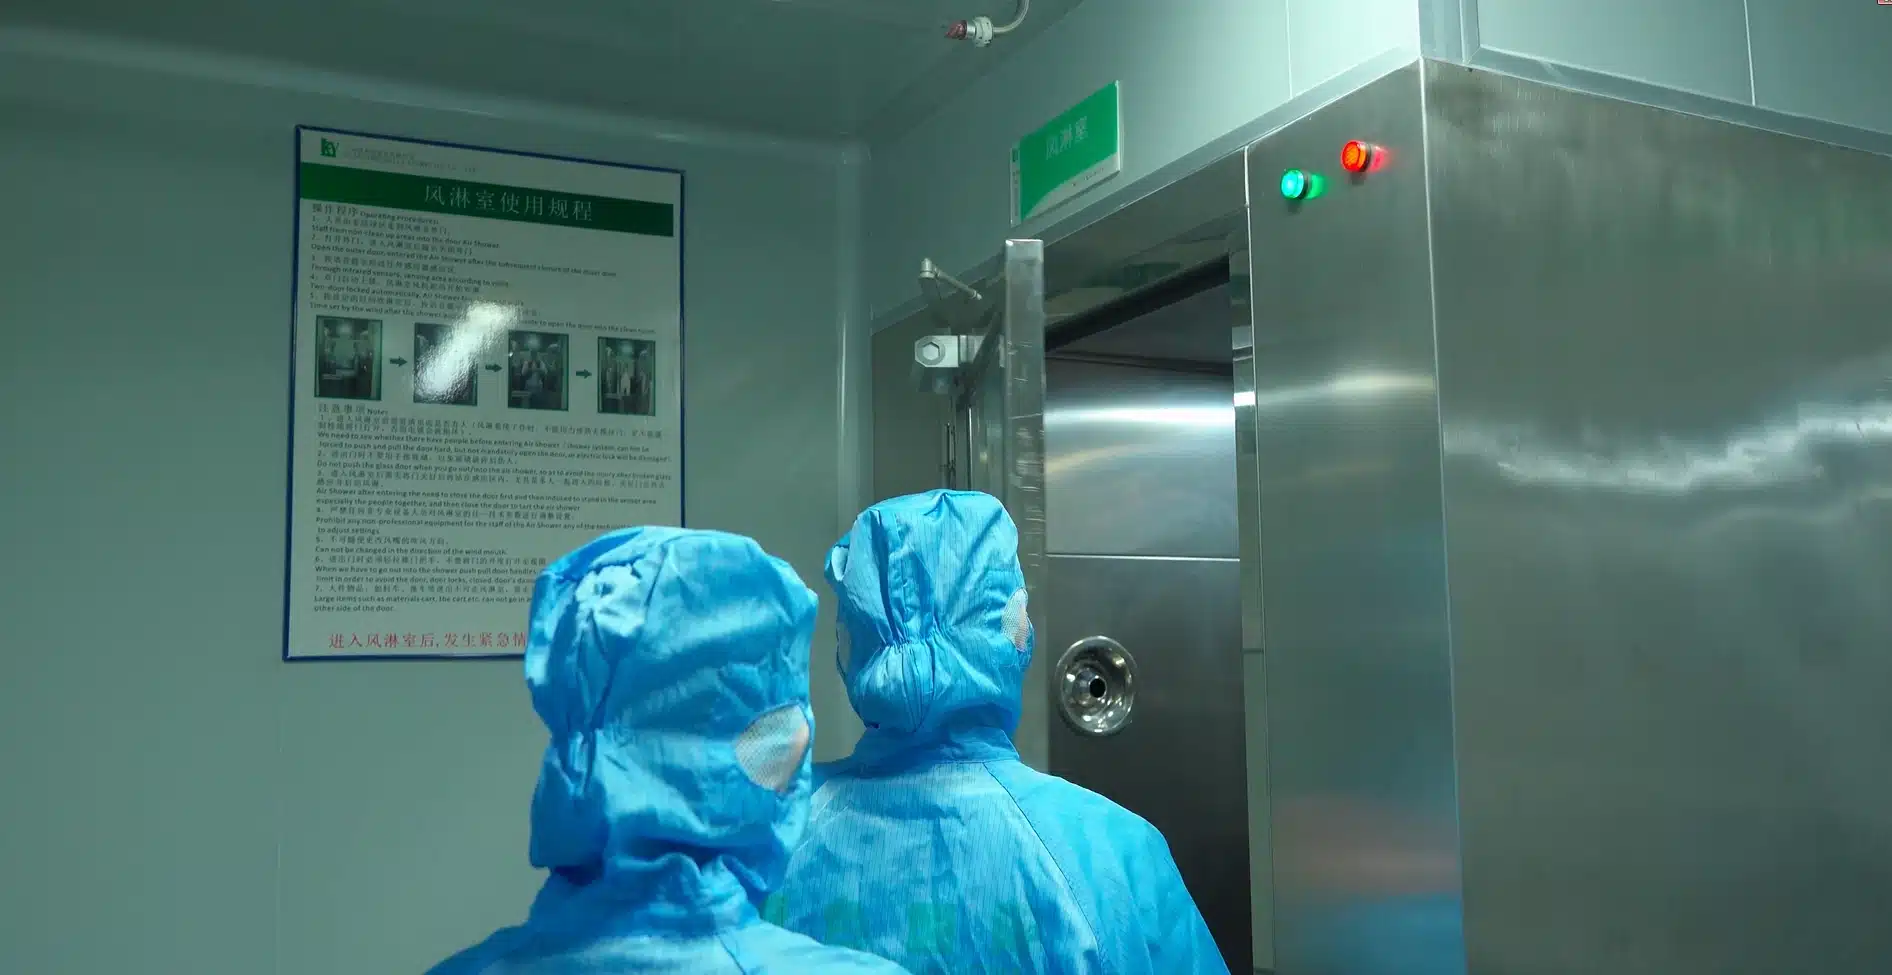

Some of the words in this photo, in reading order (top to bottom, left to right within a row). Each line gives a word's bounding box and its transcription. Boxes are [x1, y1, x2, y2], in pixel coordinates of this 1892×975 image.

[424, 184, 595, 222] 风淋室使用规程
[346, 285, 370, 294] locked
[330, 431, 349, 439] need
[373, 433, 404, 441] whether
[405, 434, 424, 442] there
[444, 436, 468, 445] people
[469, 437, 492, 445] before
[353, 442, 371, 451] push
[342, 460, 360, 469] push
[375, 461, 393, 470] glass
[412, 462, 432, 470] when
[376, 488, 407, 497] entering
[449, 490, 467, 498] close
[581, 494, 599, 502] stand
[316, 496, 352, 505] especially
[367, 497, 393, 506] people
[555, 502, 580, 510] shower
[315, 516, 345, 524] Prohibit
[424, 519, 462, 528] equipment
[536, 521, 561, 529] Shower
[327, 526, 349, 535] adjust
[355, 546, 386, 555] changed
[409, 546, 441, 554] direction
[464, 547, 482, 555] wind
[315, 564, 336, 572] When
[343, 574, 363, 582] order
[314, 594, 334, 603] Large
[335, 594, 356, 602] items
